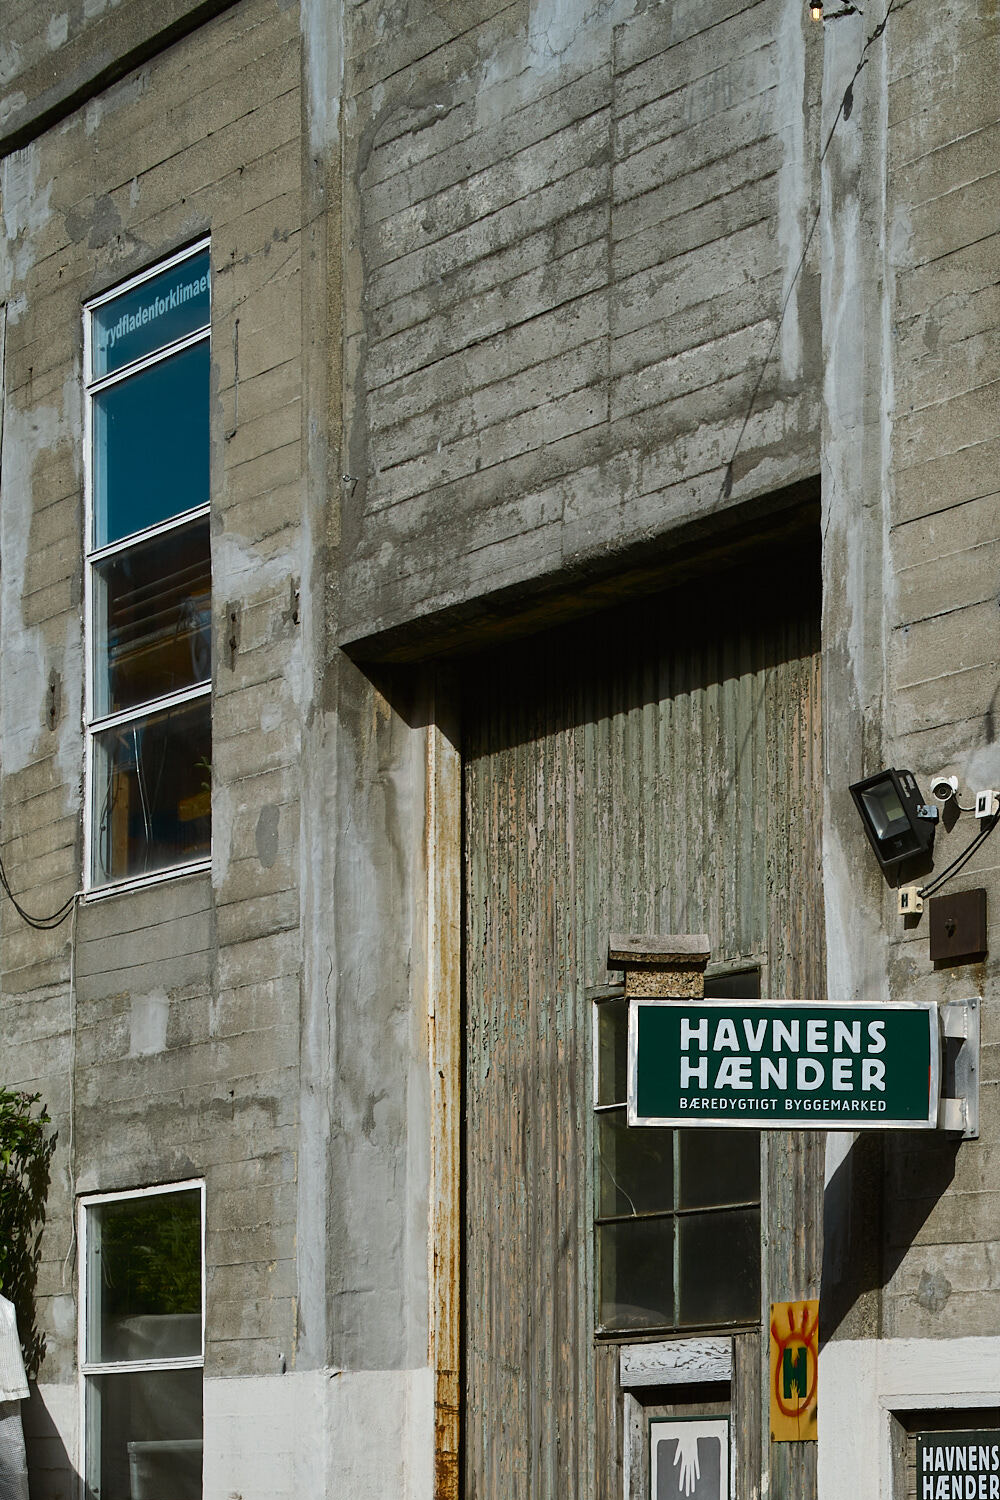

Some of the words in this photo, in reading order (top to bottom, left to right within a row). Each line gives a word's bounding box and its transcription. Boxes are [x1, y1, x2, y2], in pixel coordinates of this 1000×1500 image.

[680, 1018, 886, 1053] HAVNENS
[680, 1056, 886, 1091] HÆNDER
[680, 1097, 778, 1111] BÆREDYGTIGT
[785, 1098, 887, 1112] BYGGEMARKED
[922, 1445, 1000, 1471] HAVNENS
[922, 1474, 1000, 1500] HÆNDER
